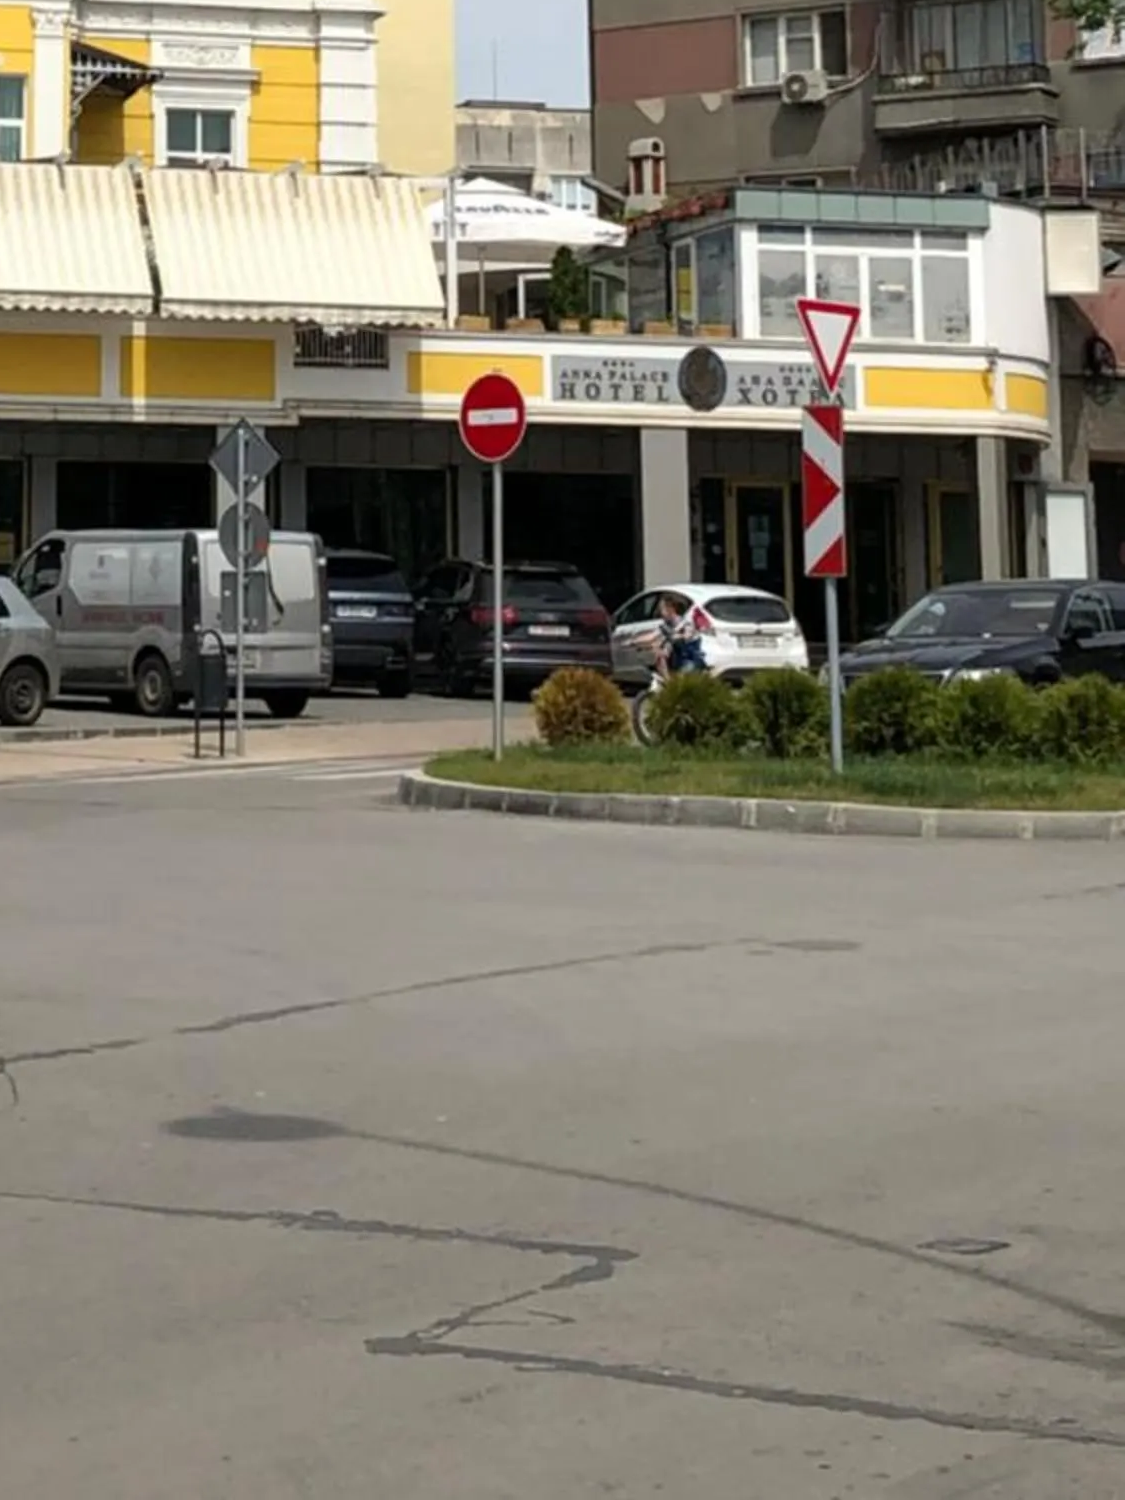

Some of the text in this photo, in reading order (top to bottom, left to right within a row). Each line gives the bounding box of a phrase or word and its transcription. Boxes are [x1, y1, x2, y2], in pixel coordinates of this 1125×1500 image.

[560, 369, 670, 383] ANNA PALACE
[560, 382, 670, 402] HOTEL
